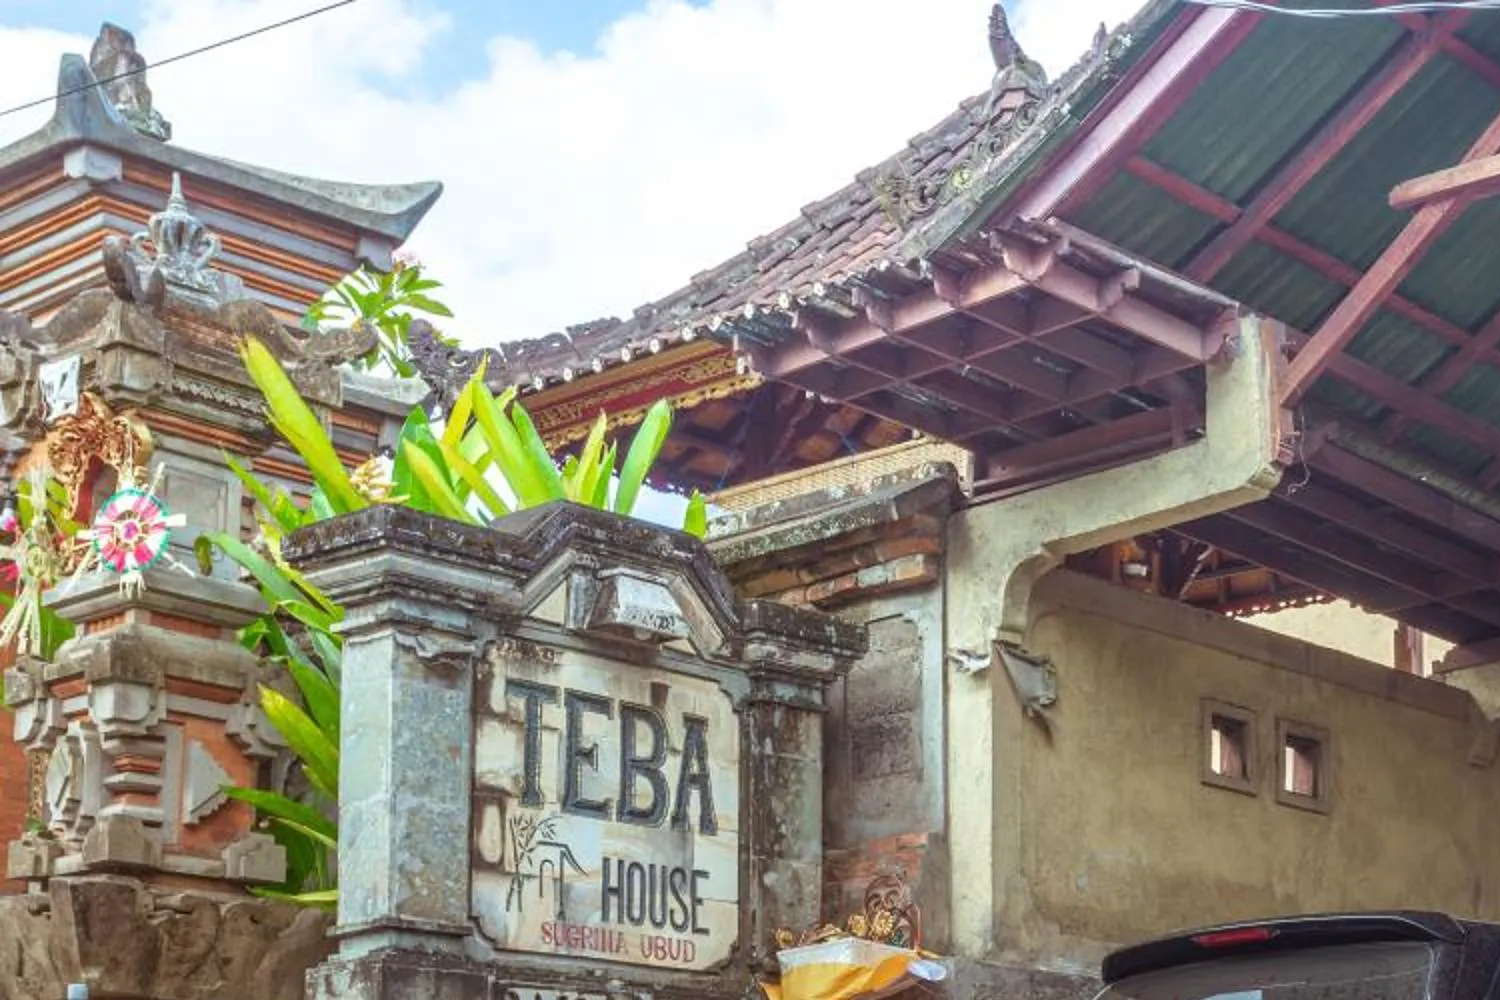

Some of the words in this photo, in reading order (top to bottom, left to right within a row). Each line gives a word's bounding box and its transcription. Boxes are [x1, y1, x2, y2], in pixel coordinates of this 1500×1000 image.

[505, 679, 718, 836] TEBA
[600, 856, 711, 936] HOUSE
[639, 933, 697, 963] UBUD
